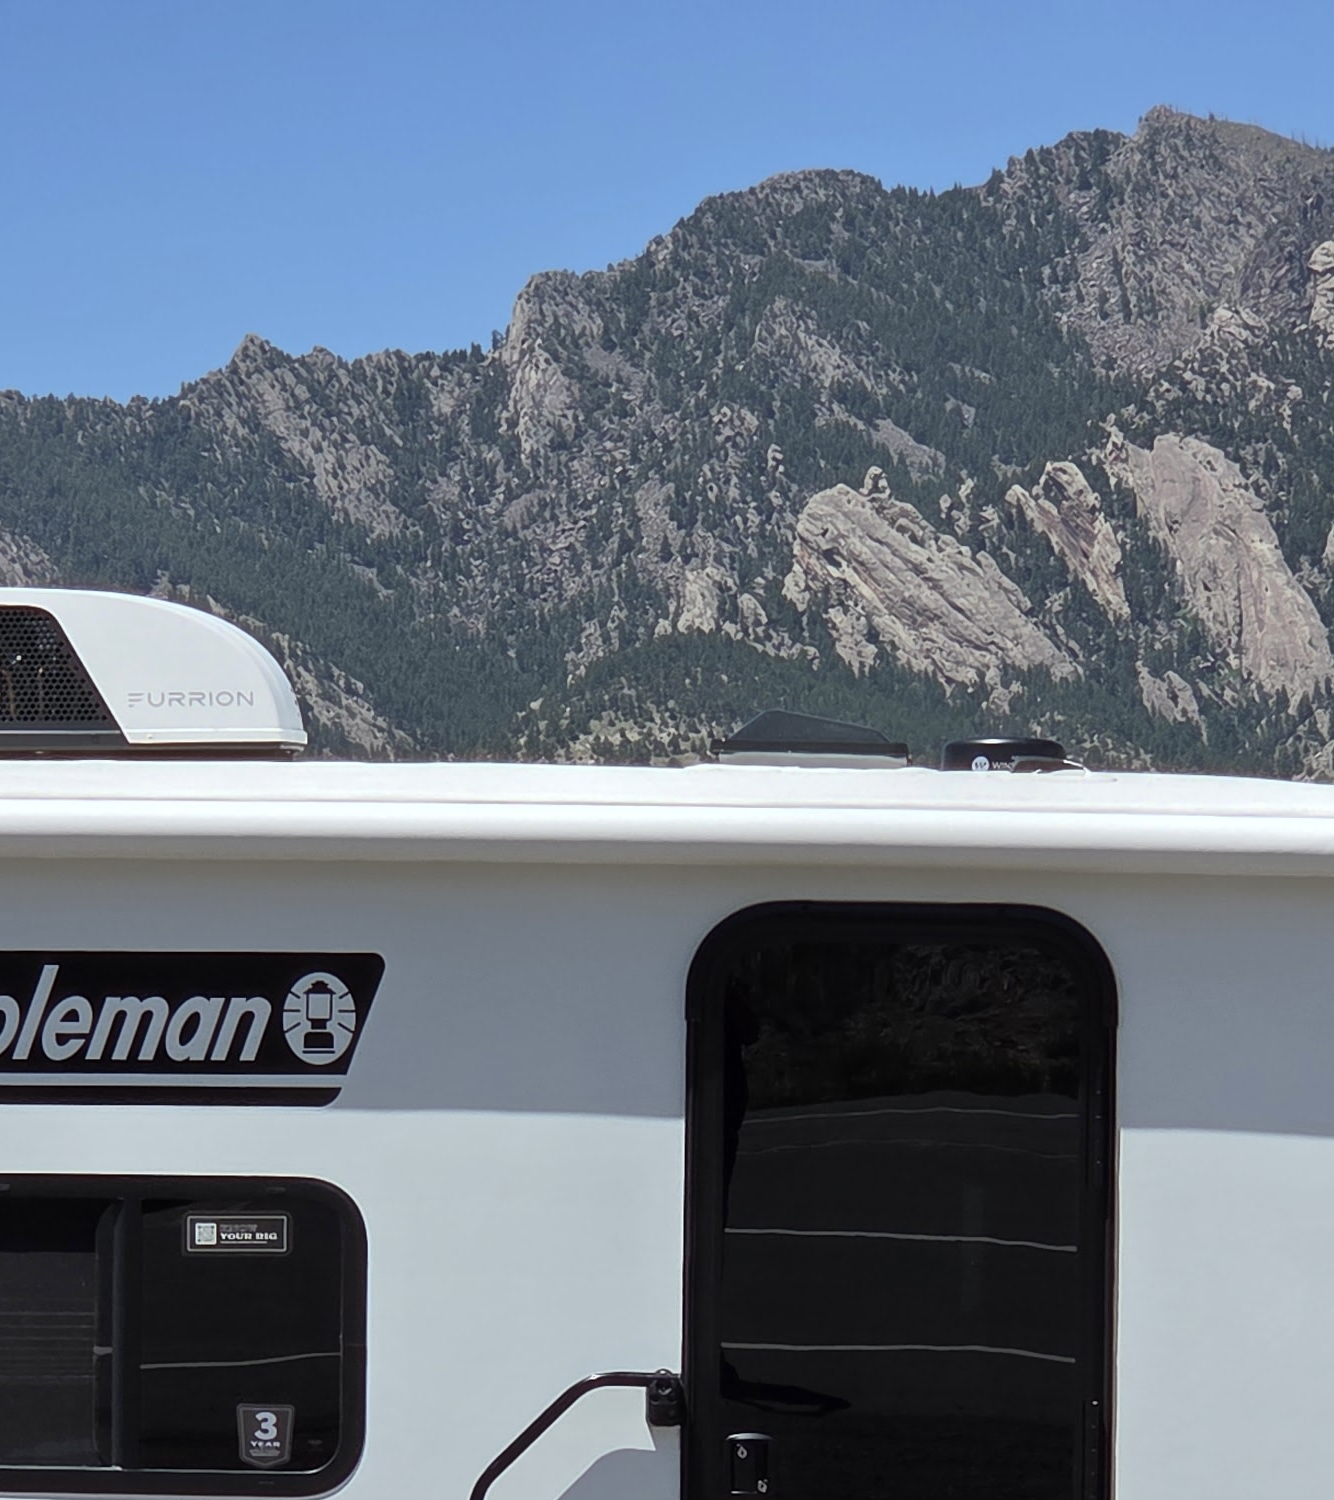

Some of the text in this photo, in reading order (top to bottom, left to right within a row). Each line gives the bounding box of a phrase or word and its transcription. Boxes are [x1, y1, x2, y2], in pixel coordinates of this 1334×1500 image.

[127, 691, 254, 707] FURRION
[220, 1232, 253, 1240] YOUR
[254, 1411, 277, 1440] 3
